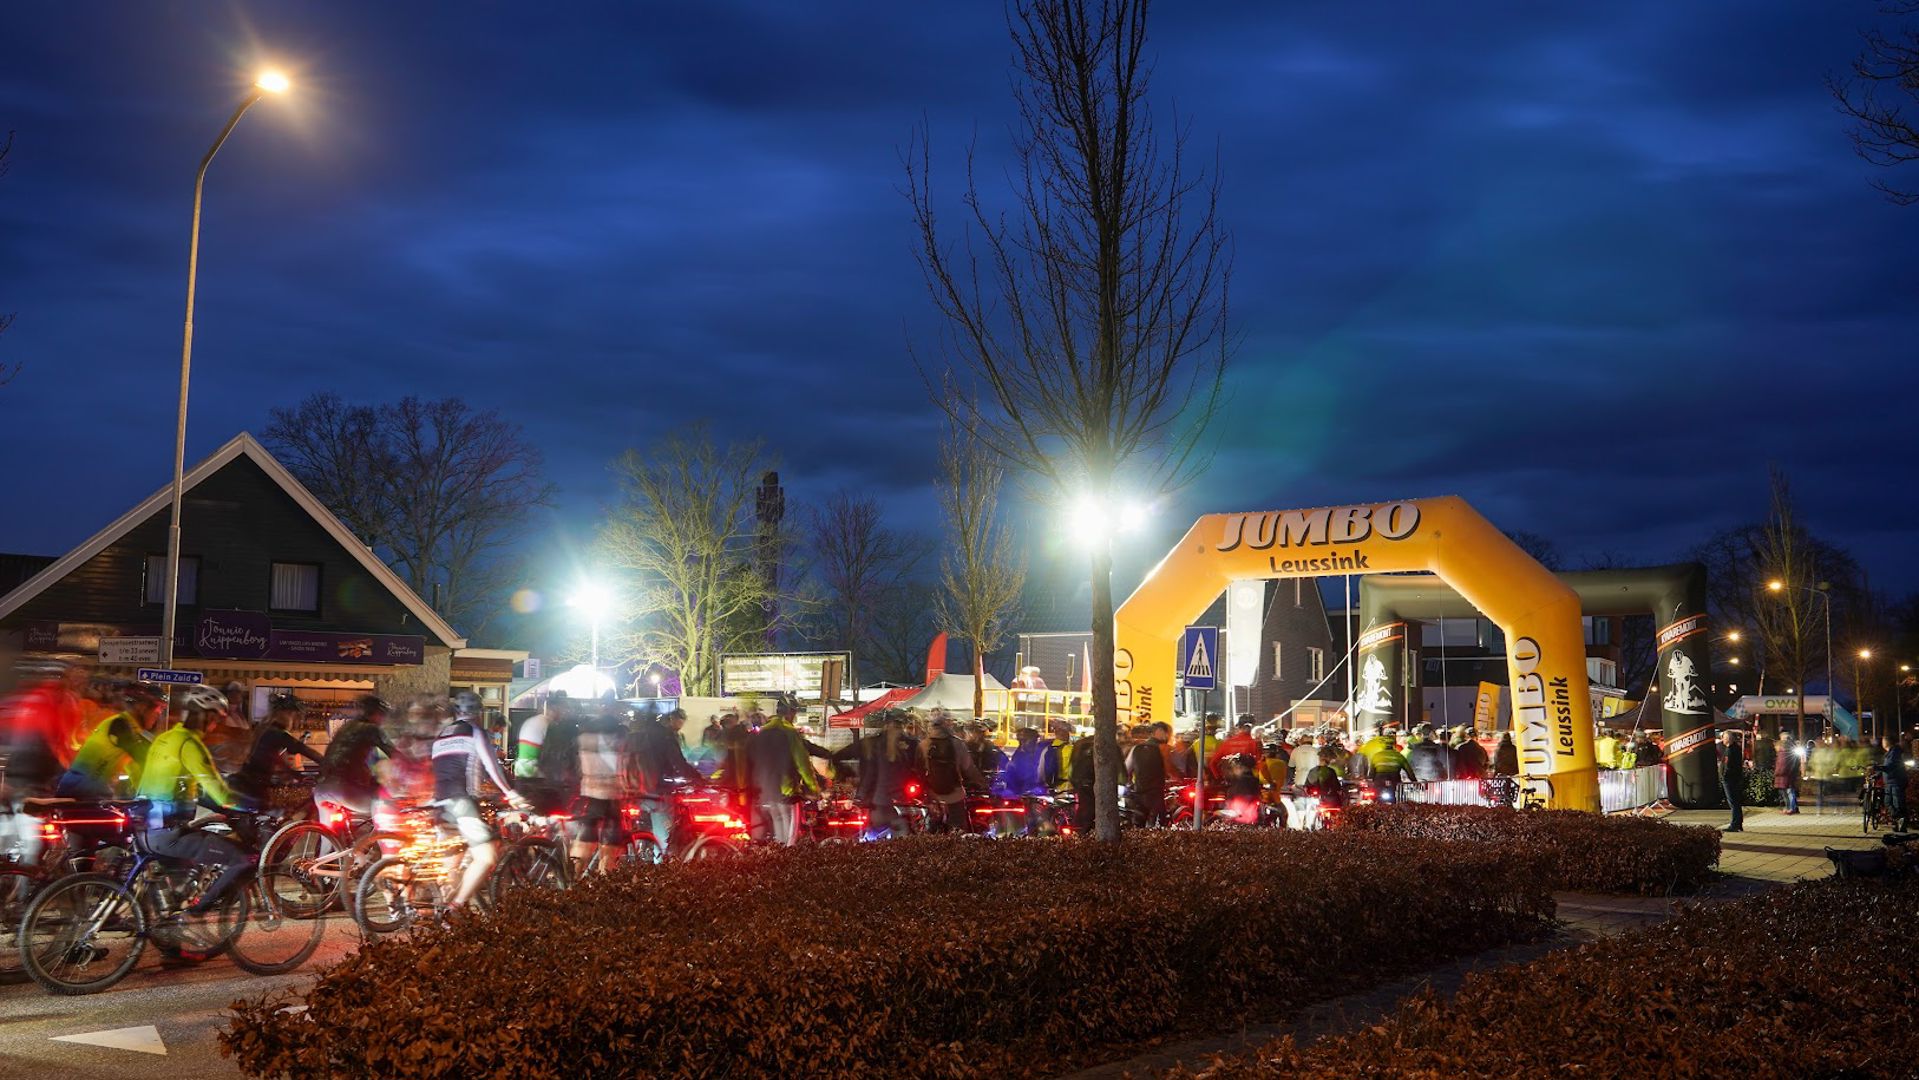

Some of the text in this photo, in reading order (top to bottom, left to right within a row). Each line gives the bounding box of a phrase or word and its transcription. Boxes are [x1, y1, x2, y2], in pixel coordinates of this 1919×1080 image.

[1216, 502, 1421, 551] JUMBO
[1269, 550, 1370, 573] Leussink
[150, 672, 191, 682] Plein Zuid
[1512, 636, 1555, 809] JUMBO
[1549, 676, 1575, 756] Leussink
